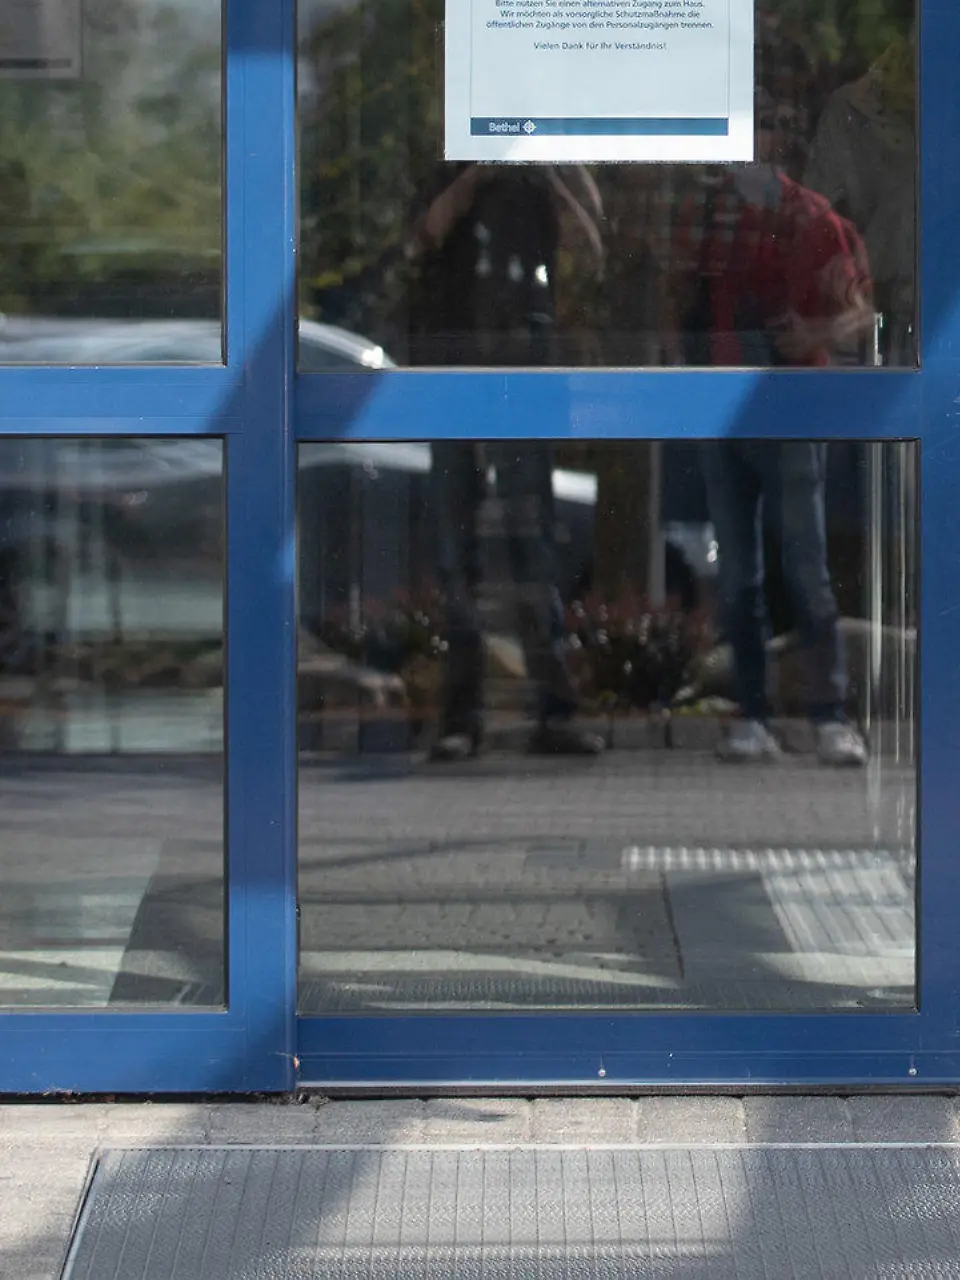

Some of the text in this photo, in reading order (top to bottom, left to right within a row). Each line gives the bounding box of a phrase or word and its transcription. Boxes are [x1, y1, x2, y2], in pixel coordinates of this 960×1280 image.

[516, 0, 543, 7] nutzen
[558, 0, 581, 7] einen
[582, 0, 631, 7] alternativen
[632, 0, 663, 9] Zugang
[565, 9, 613, 20] vorsorgliche
[533, 41, 559, 50] Vielen
[561, 41, 584, 50] Dank
[488, 122, 521, 133] Bethel
